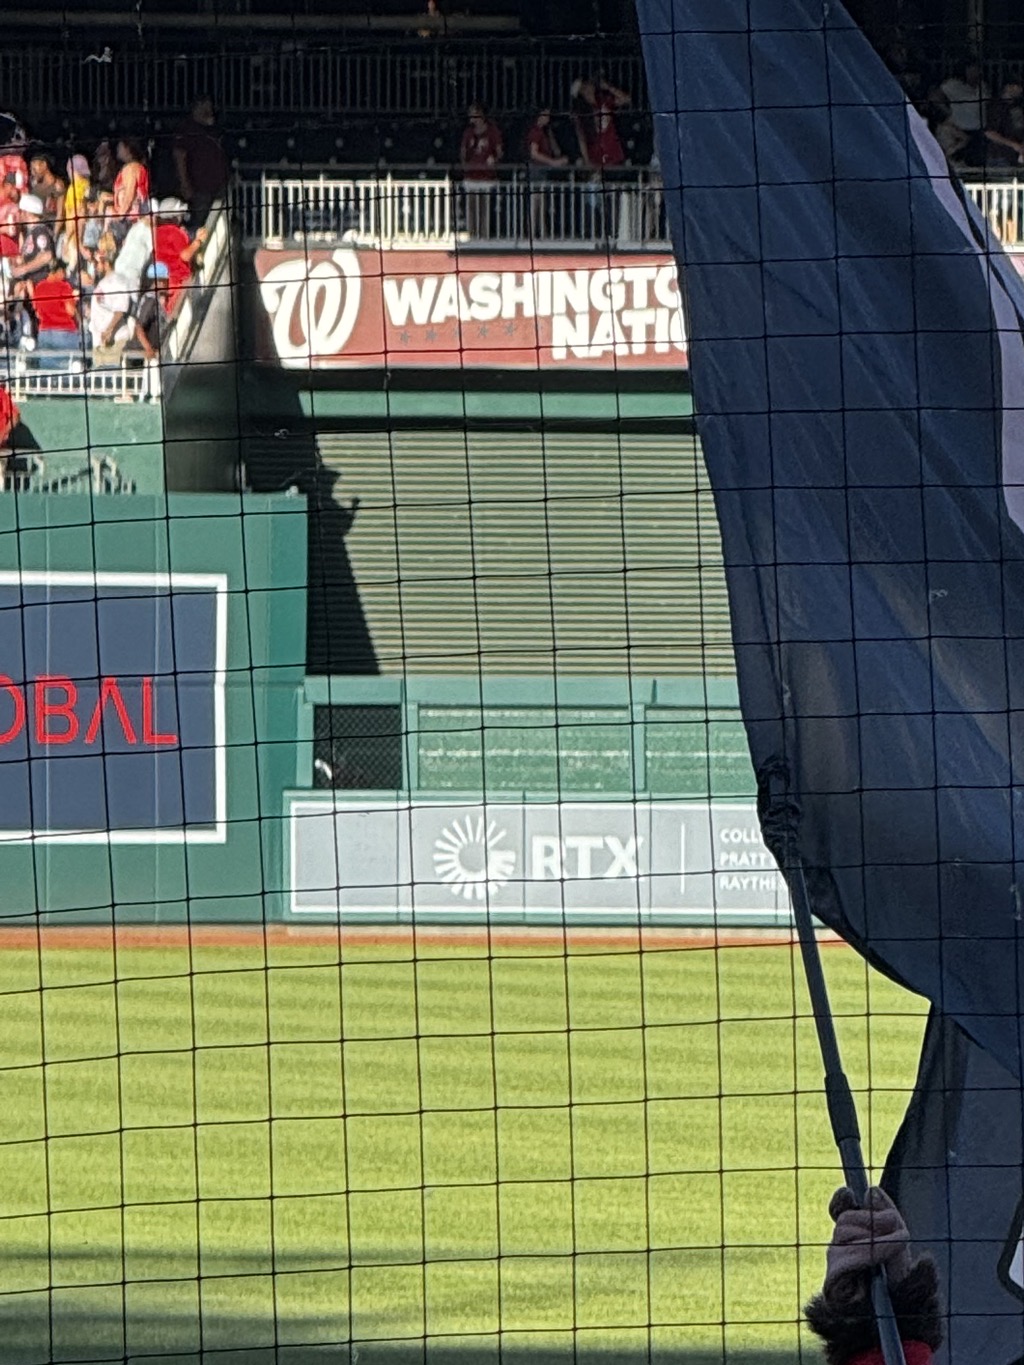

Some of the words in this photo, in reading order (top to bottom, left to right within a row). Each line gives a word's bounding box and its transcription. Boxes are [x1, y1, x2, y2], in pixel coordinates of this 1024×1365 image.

[720, 828, 764, 844] COLL
[531, 834, 644, 882] RTX
[720, 851, 767, 867] PRATT
